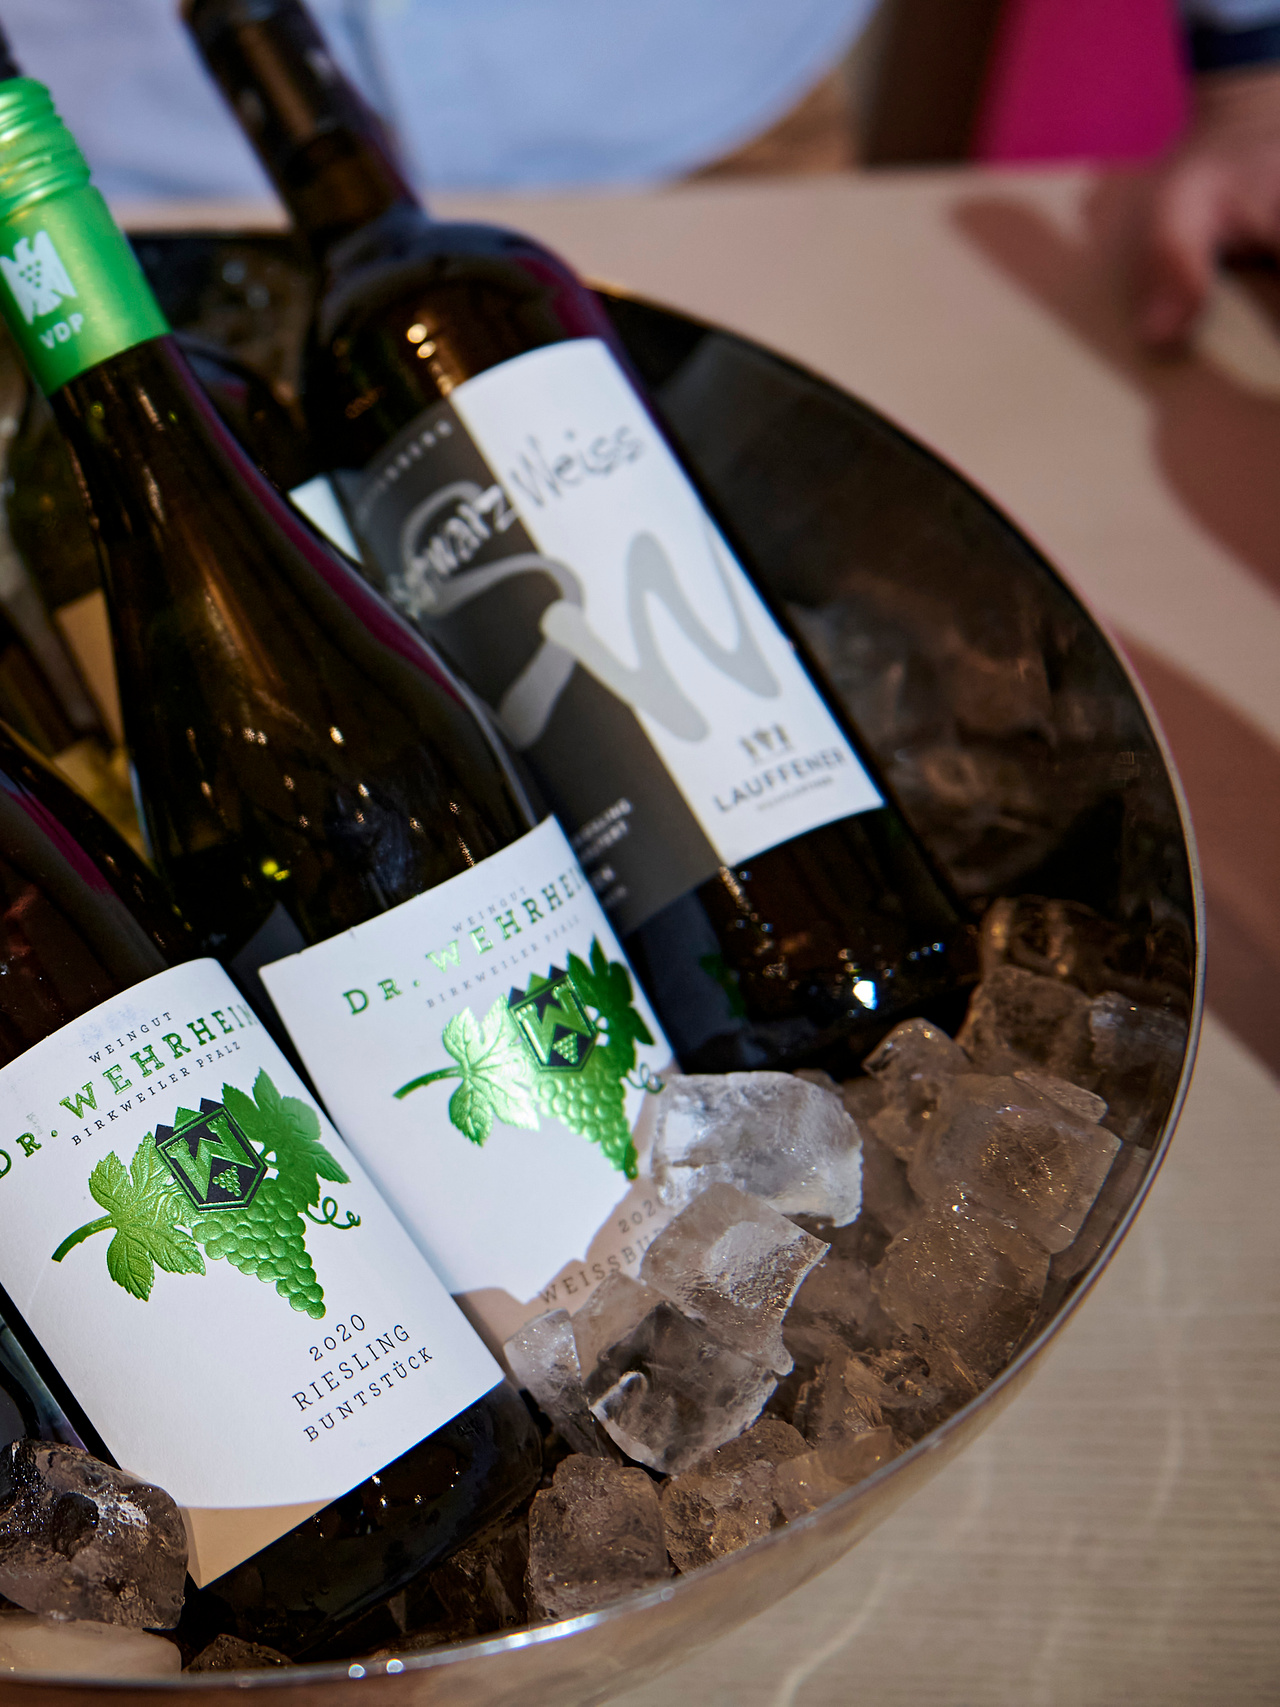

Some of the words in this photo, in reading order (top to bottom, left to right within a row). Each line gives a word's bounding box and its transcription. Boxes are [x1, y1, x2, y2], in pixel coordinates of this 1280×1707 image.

[39, 312, 84, 350] VDP
[712, 747, 847, 814] LAUFFENER
[342, 978, 422, 1016] DR.
[425, 866, 583, 973] WEHRHEI
[452, 886, 528, 933] WEINGUT
[426, 943, 540, 1009] BIRKWEILER
[88, 1012, 173, 1064] WEINGUT
[72, 1067, 191, 1146] BIRKWEILER
[196, 1041, 241, 1068] PFALZ
[291, 1324, 410, 1412] RIESLING
[309, 1314, 365, 1361] 2020
[303, 1347, 433, 1443] BUNTSTÜCK
